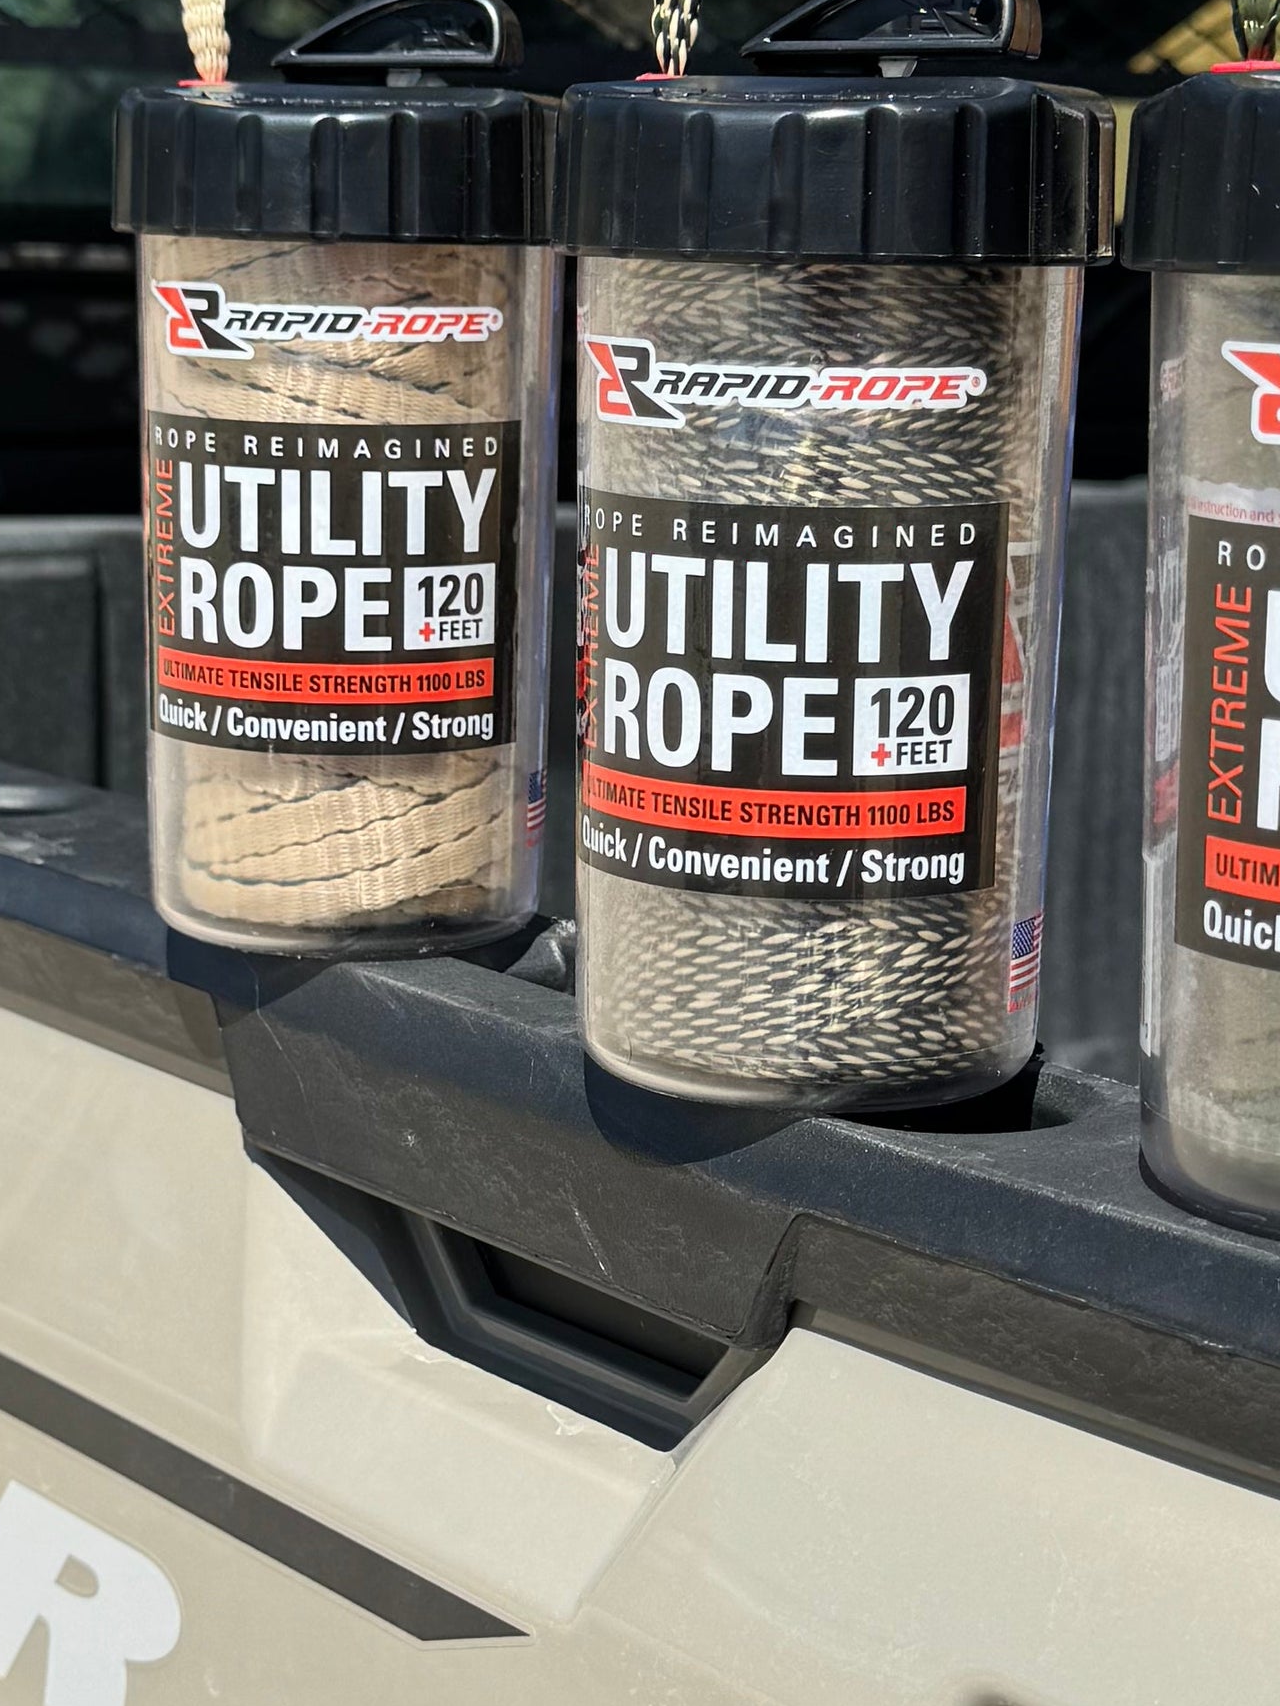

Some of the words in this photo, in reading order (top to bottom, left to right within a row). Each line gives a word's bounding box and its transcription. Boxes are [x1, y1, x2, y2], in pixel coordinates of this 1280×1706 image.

[155, 426, 216, 452] ROPE
[244, 435, 497, 459] REIMAGINED
[179, 461, 496, 556] UTILITY
[673, 519, 976, 548] REIMAGINED
[1249, 510, 1274, 522] and
[155, 459, 175, 636] EXTREME
[180, 556, 392, 651] ROPE
[418, 572, 484, 618] 120
[605, 547, 974, 663] UTILITY
[164, 659, 224, 686] ULTIMATE
[228, 669, 303, 692] TENSILE
[309, 674, 412, 694] STRENGTH
[417, 673, 451, 692] 1100
[456, 669, 485, 689] LBS
[1207, 583, 1252, 825] EXTREME
[160, 693, 207, 732] Quick
[227, 707, 386, 742] Convenient
[412, 710, 494, 741] Strong
[604, 658, 838, 776] ROPE
[870, 684, 955, 739] 120
[651, 791, 732, 822] TENSILE
[739, 802, 861, 827] STRENGTH
[867, 801, 910, 826] 1100
[917, 800, 955, 824] LBS
[582, 814, 627, 862] Quick
[648, 835, 830, 884] Convenient
[861, 849, 965, 884] Strong
